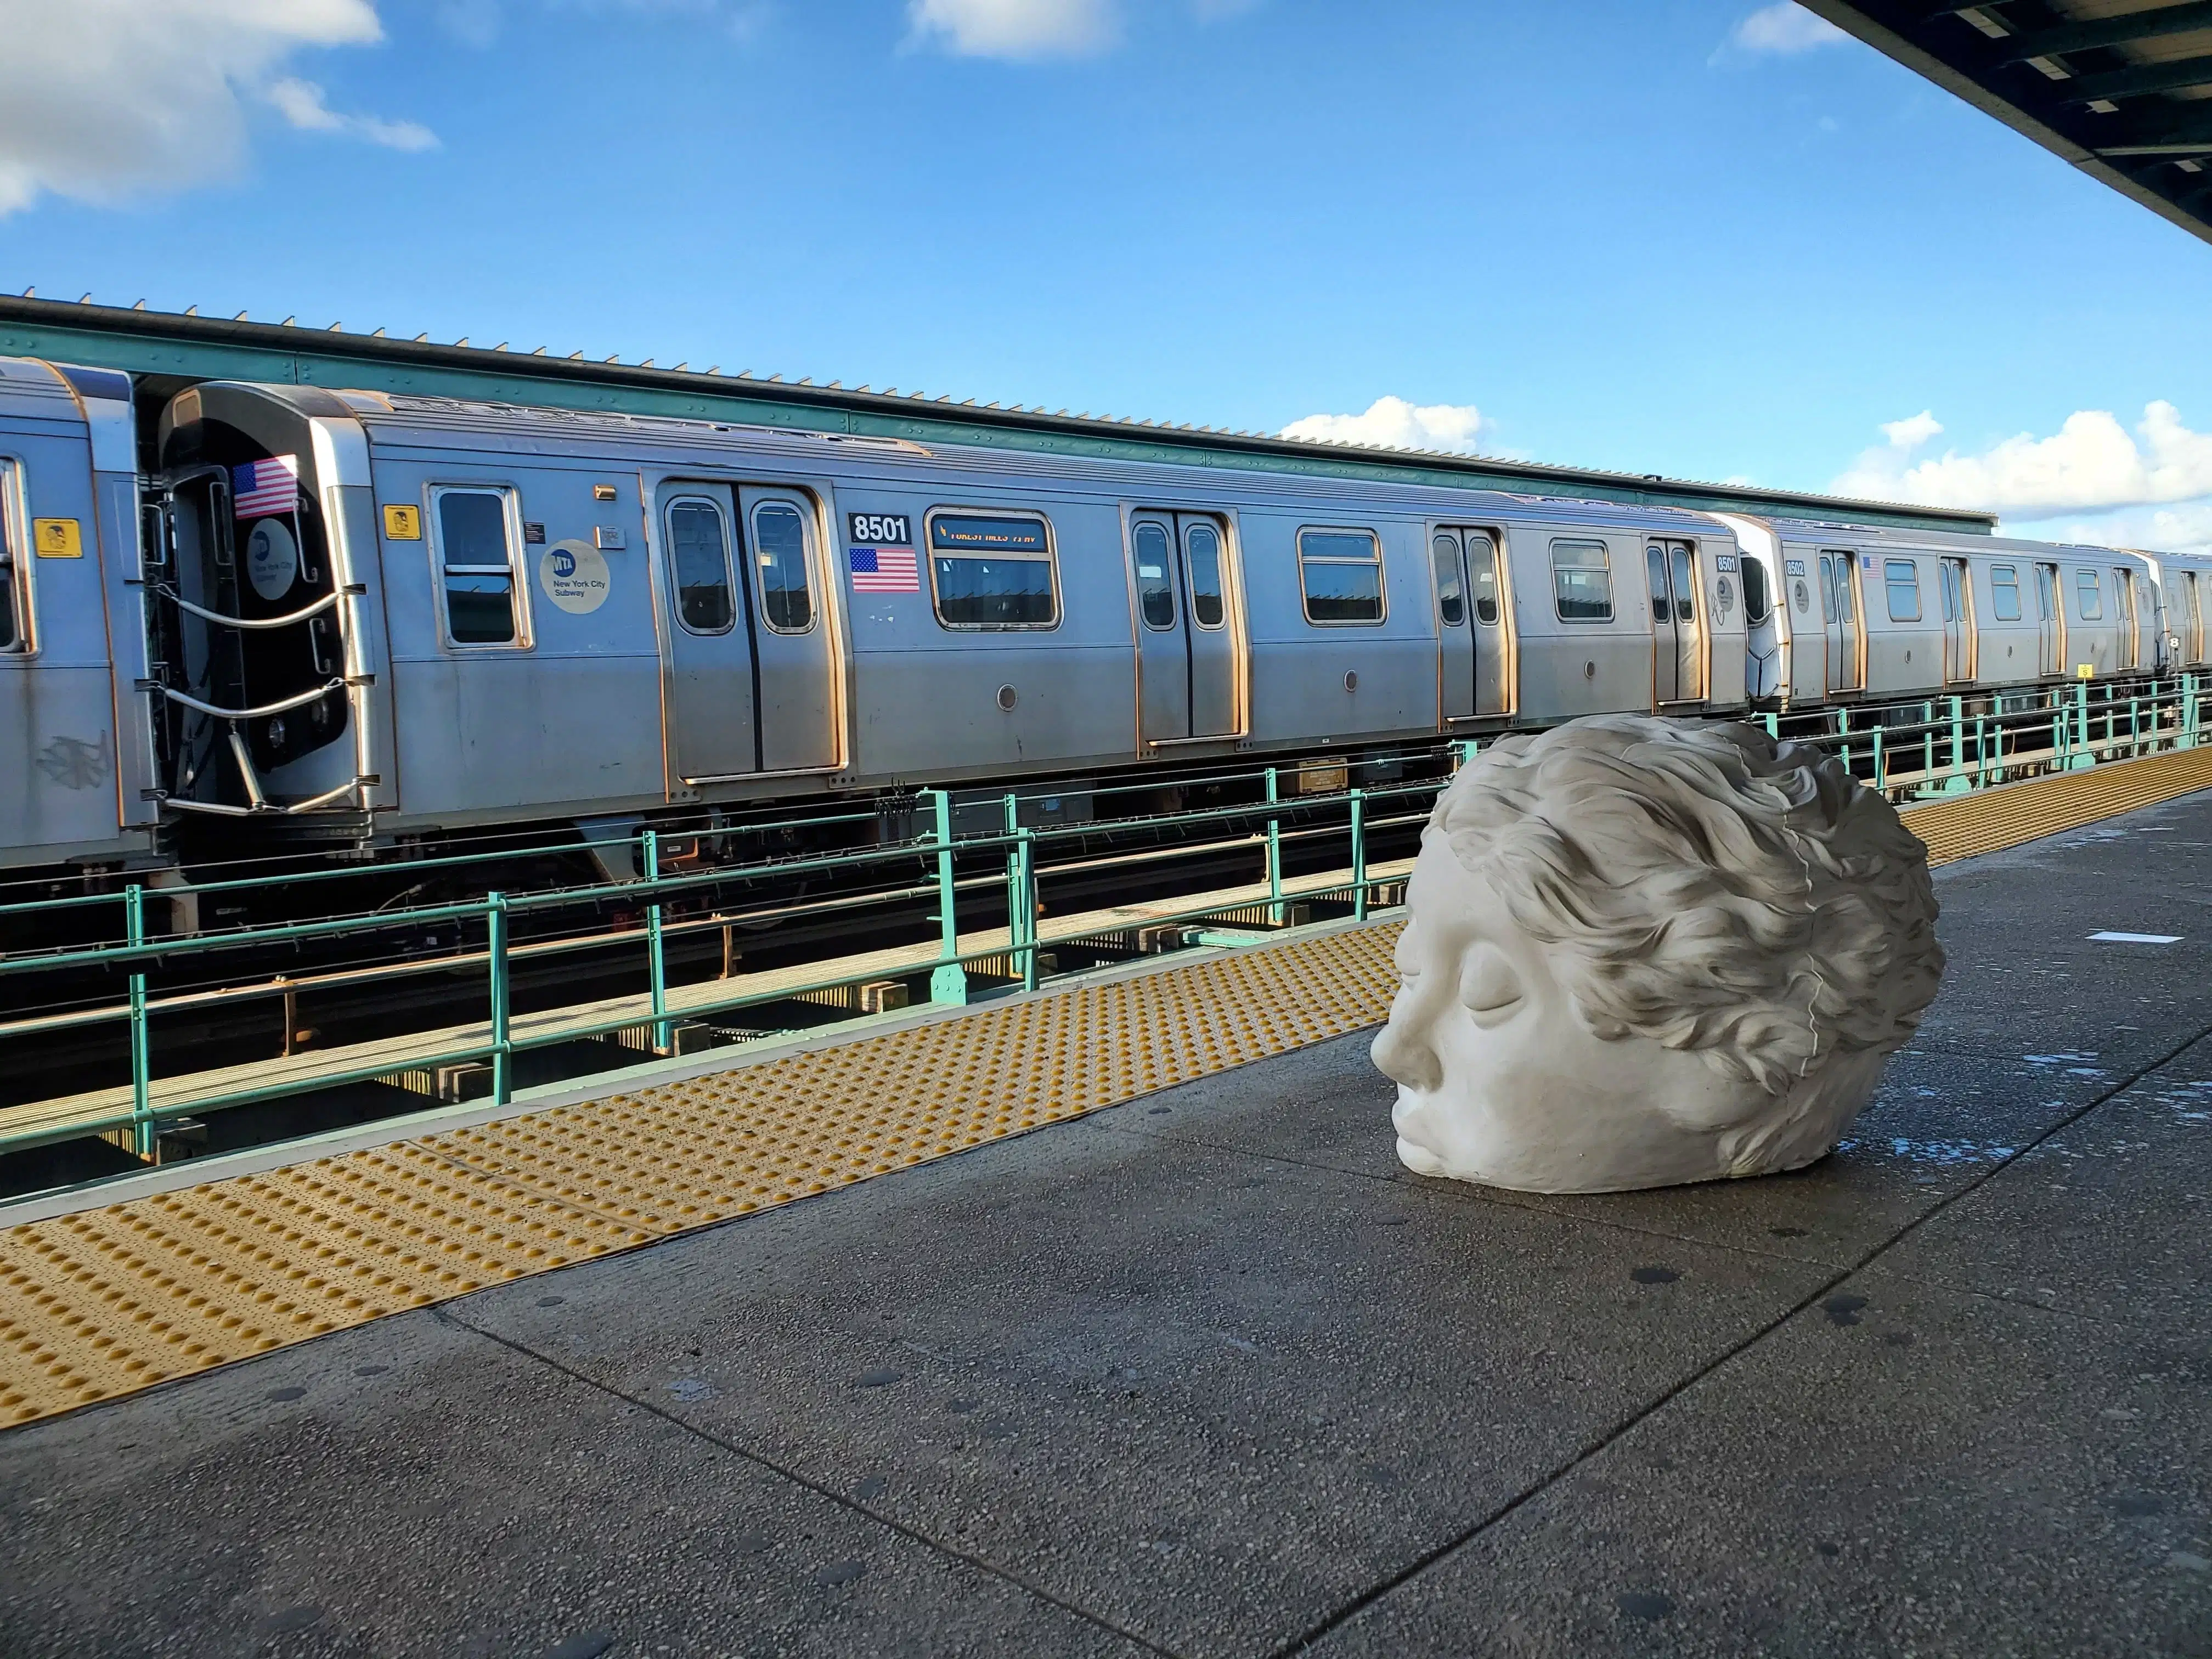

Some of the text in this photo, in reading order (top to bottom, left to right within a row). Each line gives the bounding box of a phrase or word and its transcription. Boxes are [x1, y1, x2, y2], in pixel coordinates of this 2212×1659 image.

[855, 516, 907, 542] 8501
[551, 552, 573, 572] MTA
[1718, 556, 1735, 571] 8501
[1787, 561, 1804, 575] 8502
[591, 580, 606, 589] City
[555, 589, 585, 597] Subway
[2170, 637, 2179, 647] 8
